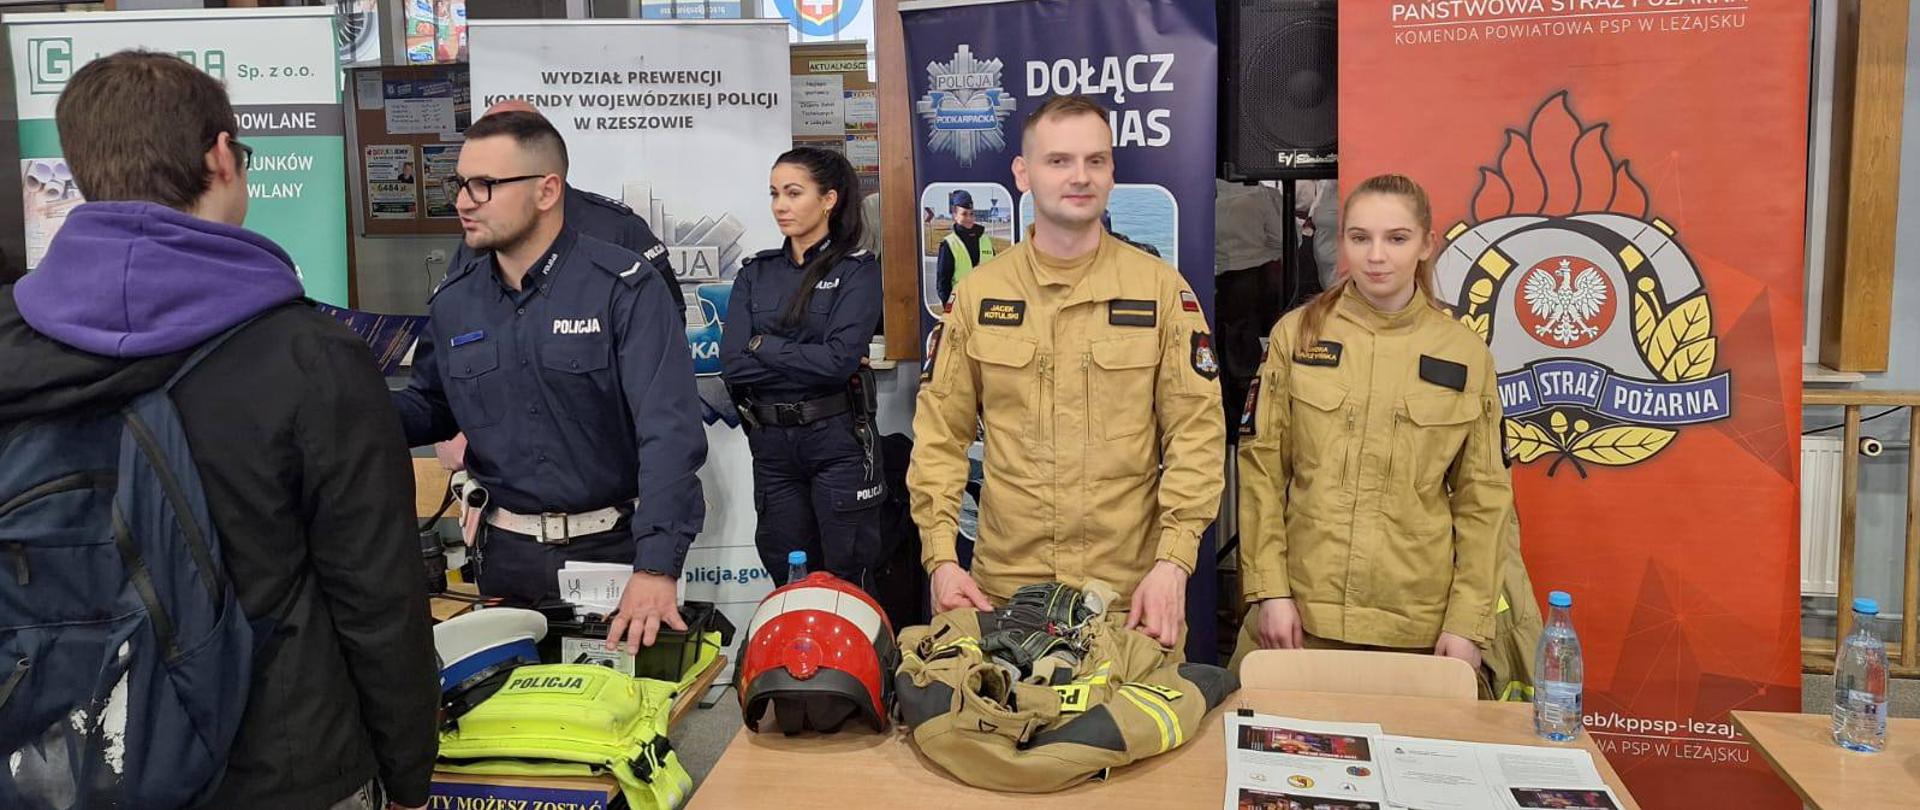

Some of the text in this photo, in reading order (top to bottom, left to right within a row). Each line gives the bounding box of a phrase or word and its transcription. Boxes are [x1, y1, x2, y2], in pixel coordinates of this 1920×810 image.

[1392, 0, 1544, 21] PAŃSTWOWA
[1395, 13, 1746, 45] KOMENDA POWIATOWA PSP W LEŻAJSKU
[237, 64, 264, 81] Sp.
[269, 66, 278, 78] z
[283, 65, 315, 78] o.o.
[541, 70, 722, 86] WYDZIAŁ PREWENCJI
[1026, 53, 1175, 104] DOŁĄCZ
[938, 75, 992, 88] POLICJA
[579, 90, 711, 110] WOJEWÓDZKIEJ
[718, 92, 778, 109] POLICJI
[574, 115, 694, 130] W RZESZOWIE
[937, 115, 995, 124] PODKARPACKA
[247, 183, 303, 198] WLANY
[673, 250, 712, 276] JA
[553, 318, 601, 334] POLICJA
[690, 341, 720, 359] KA
[1538, 371, 1599, 399] STRAŻ
[1614, 385, 1719, 418] POŻARNA
[509, 676, 583, 690] POLICJA
[1582, 711, 1742, 738] eb/kppsp-lezaj
[1622, 740, 1650, 756] PSP
[1655, 744, 1671, 758] W
[430, 795, 453, 809] TY
[457, 795, 528, 810] MOŻESZ
